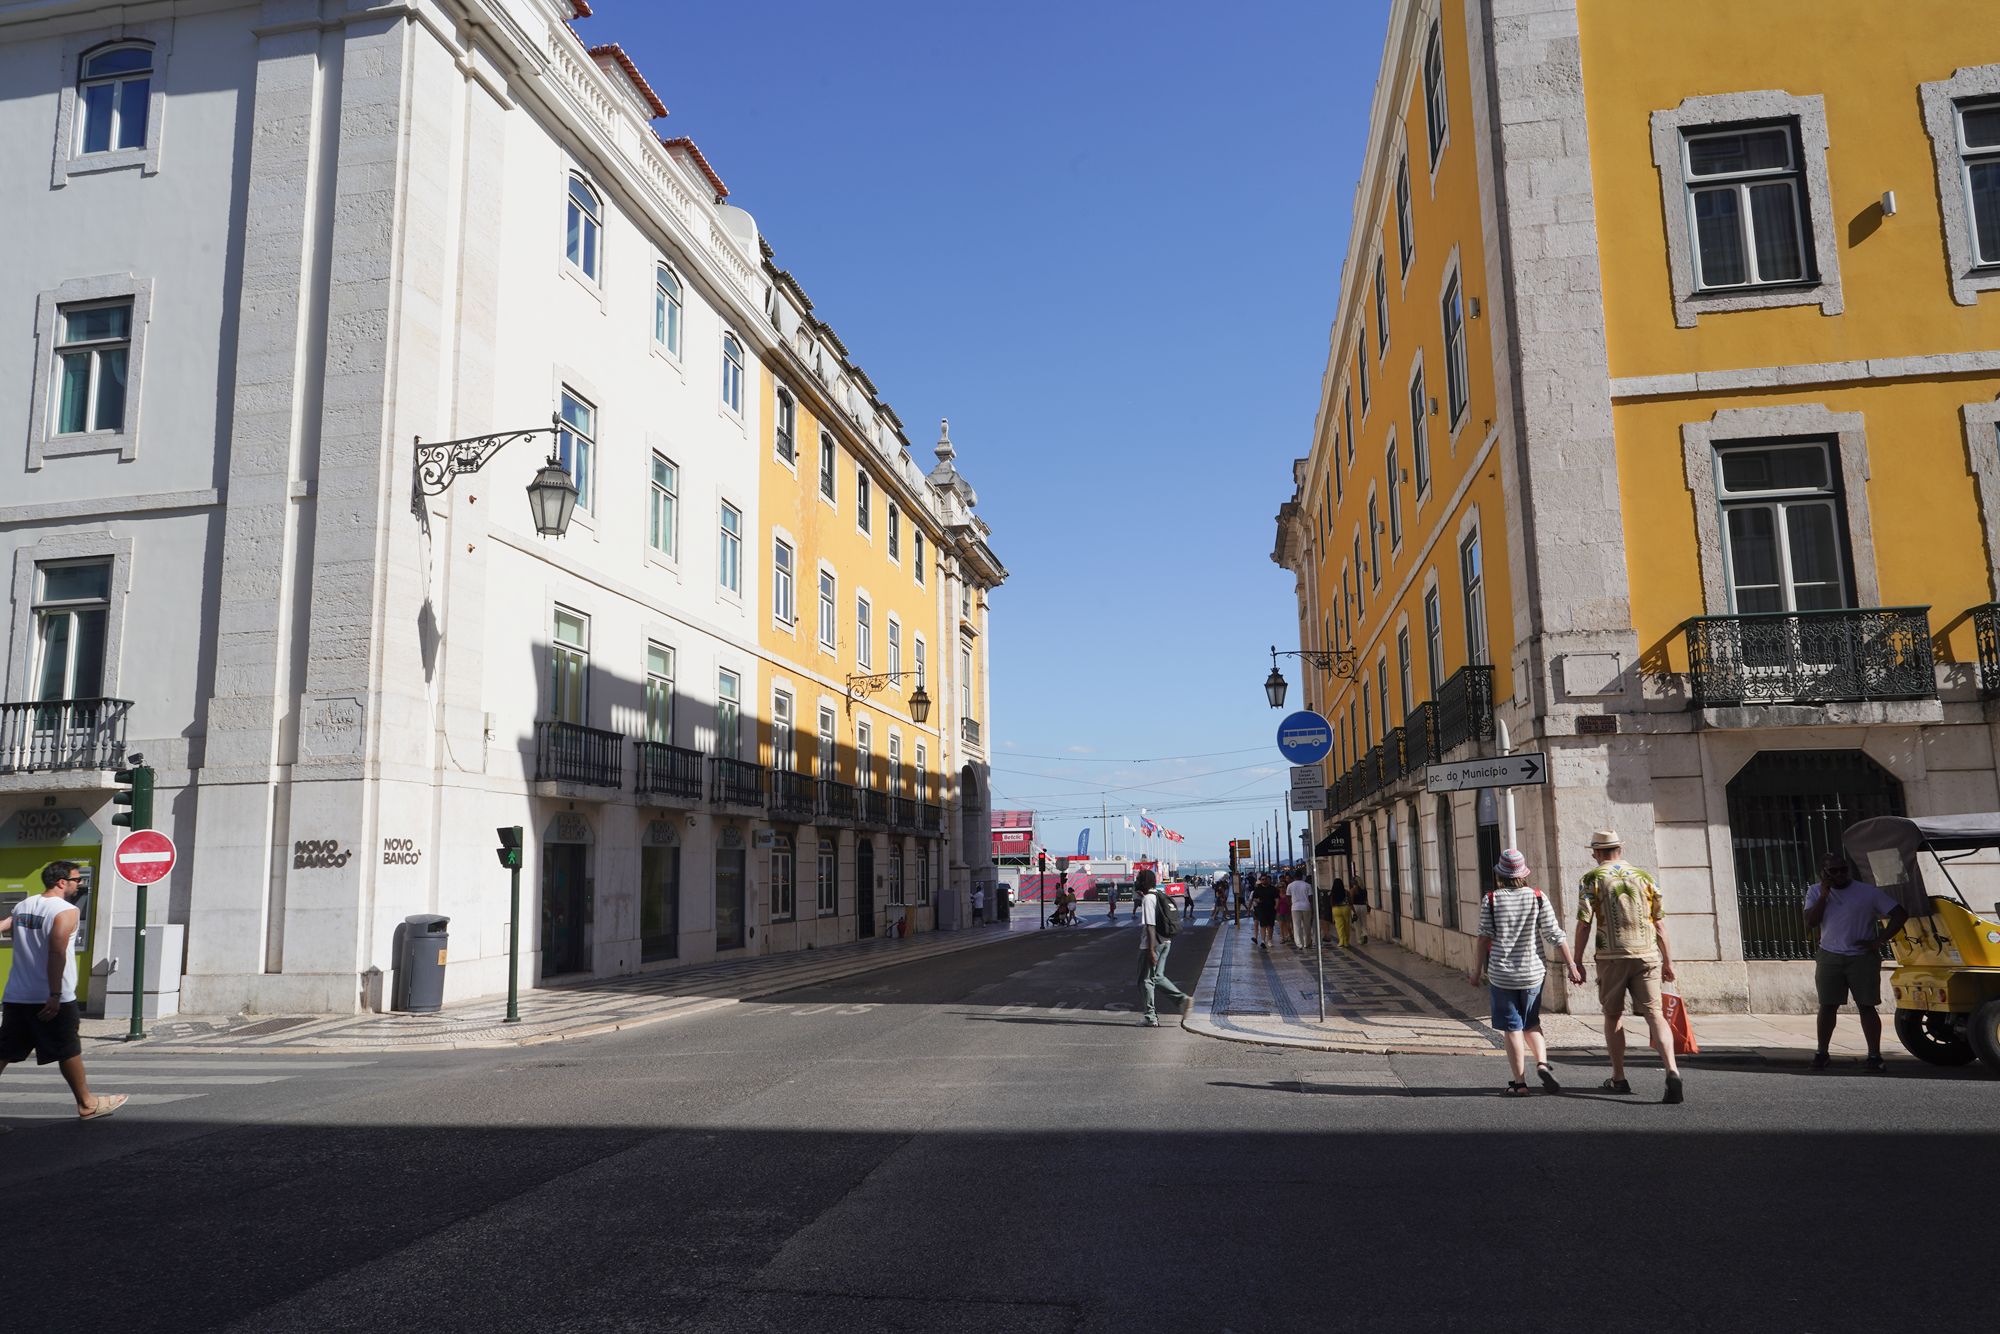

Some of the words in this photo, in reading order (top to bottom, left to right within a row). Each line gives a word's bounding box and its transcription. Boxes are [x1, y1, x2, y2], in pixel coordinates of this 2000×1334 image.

[1447, 771, 1458, 781] do
[1462, 766, 1508, 780] Município
[17, 812, 60, 827] NOVO
[16, 826, 67, 841] BANCO
[295, 839, 339, 855] NOVO
[384, 838, 413, 851] NOVO
[293, 853, 347, 869] BANCO
[383, 852, 418, 865] BANCO
